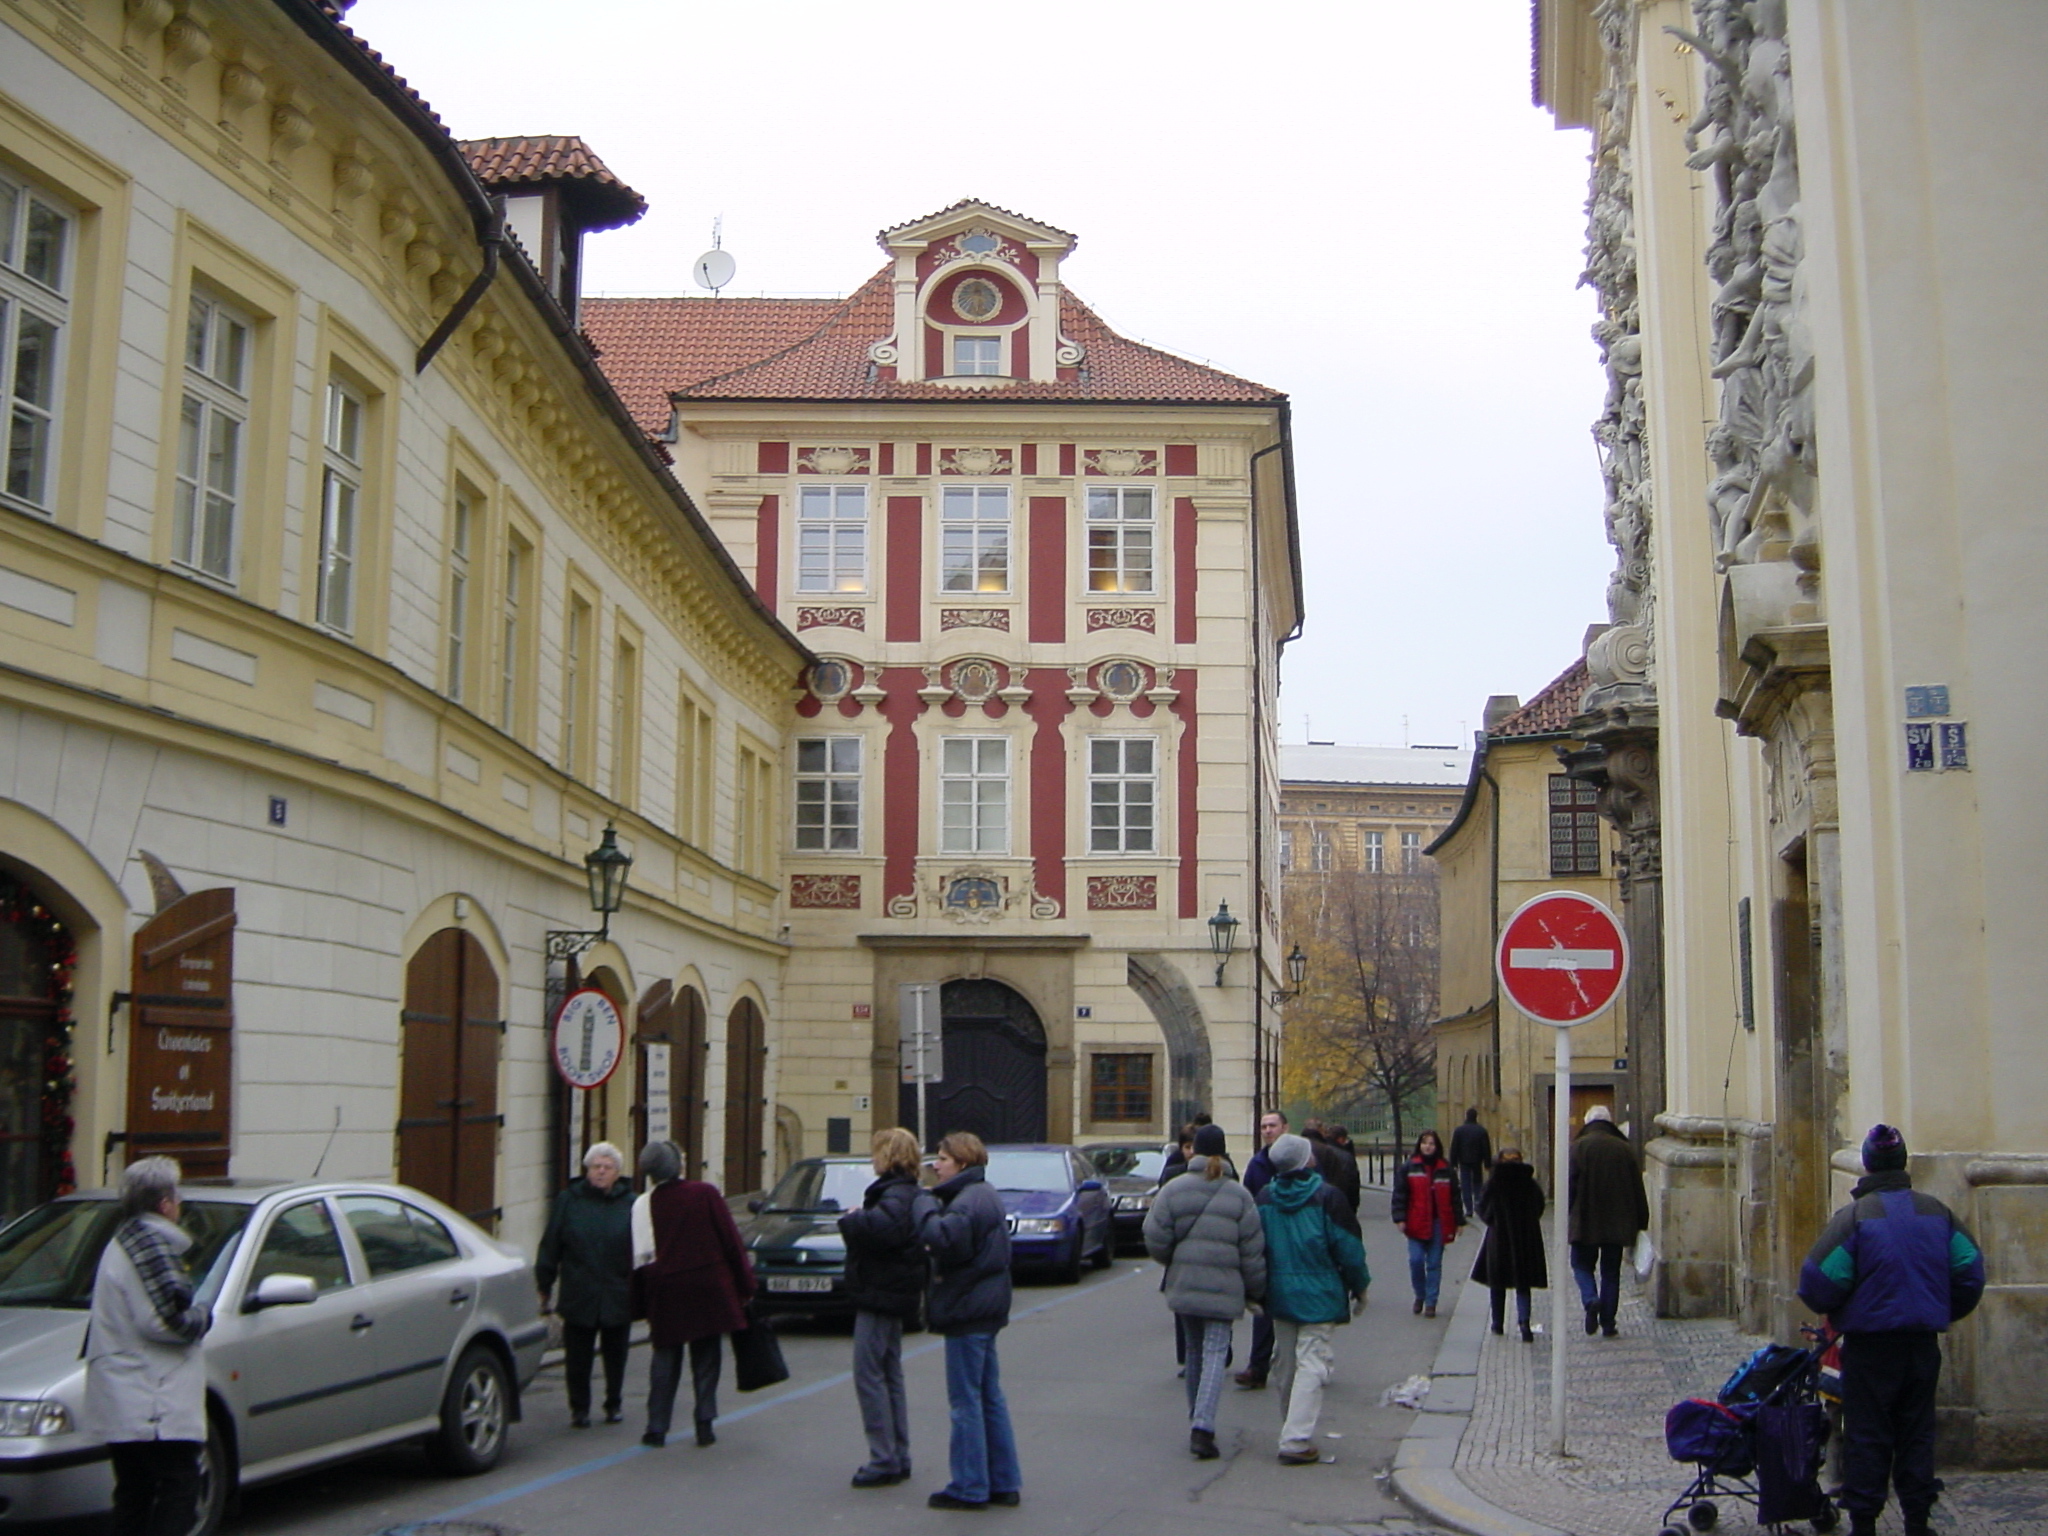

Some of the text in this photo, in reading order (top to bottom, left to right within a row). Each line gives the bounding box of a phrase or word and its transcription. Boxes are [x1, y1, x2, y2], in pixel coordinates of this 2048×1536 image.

[563, 999, 616, 1025] BIG BEN
[559, 1047, 613, 1081] BOOK SHOP
[152, 1086, 214, 1113] Switzerland
